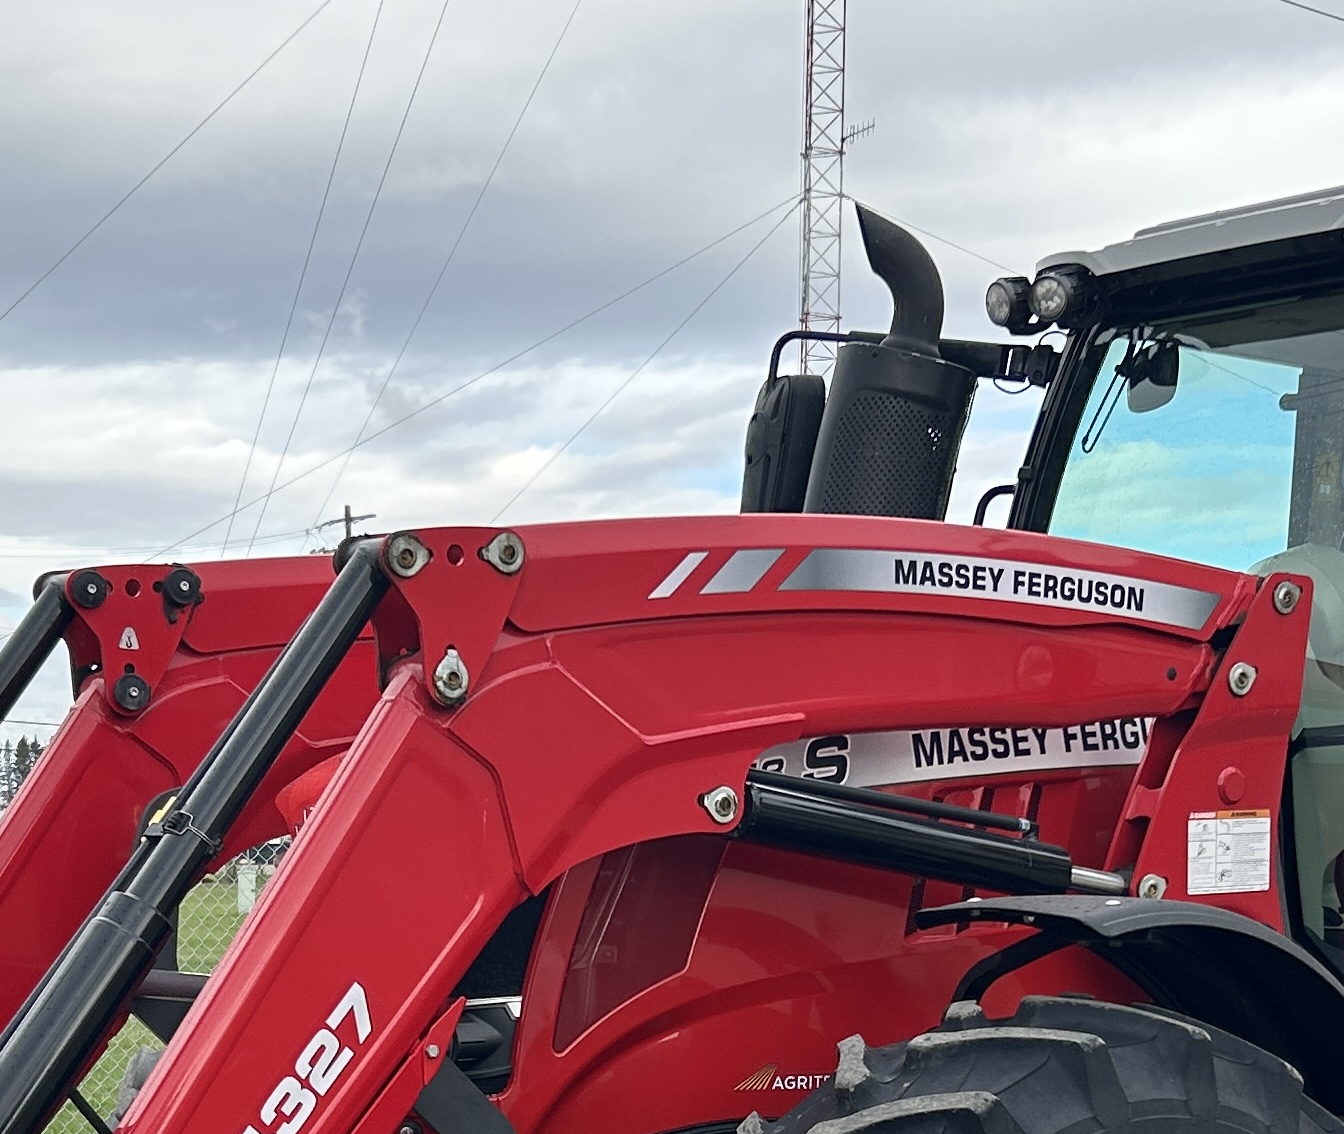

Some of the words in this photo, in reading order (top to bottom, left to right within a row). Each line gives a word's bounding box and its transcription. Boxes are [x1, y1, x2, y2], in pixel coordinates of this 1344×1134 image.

[893, 558, 1005, 593] MASSEY
[1012, 569, 1145, 612] FERGUSON
[803, 733, 852, 784] S
[911, 725, 1049, 769] MASSEY
